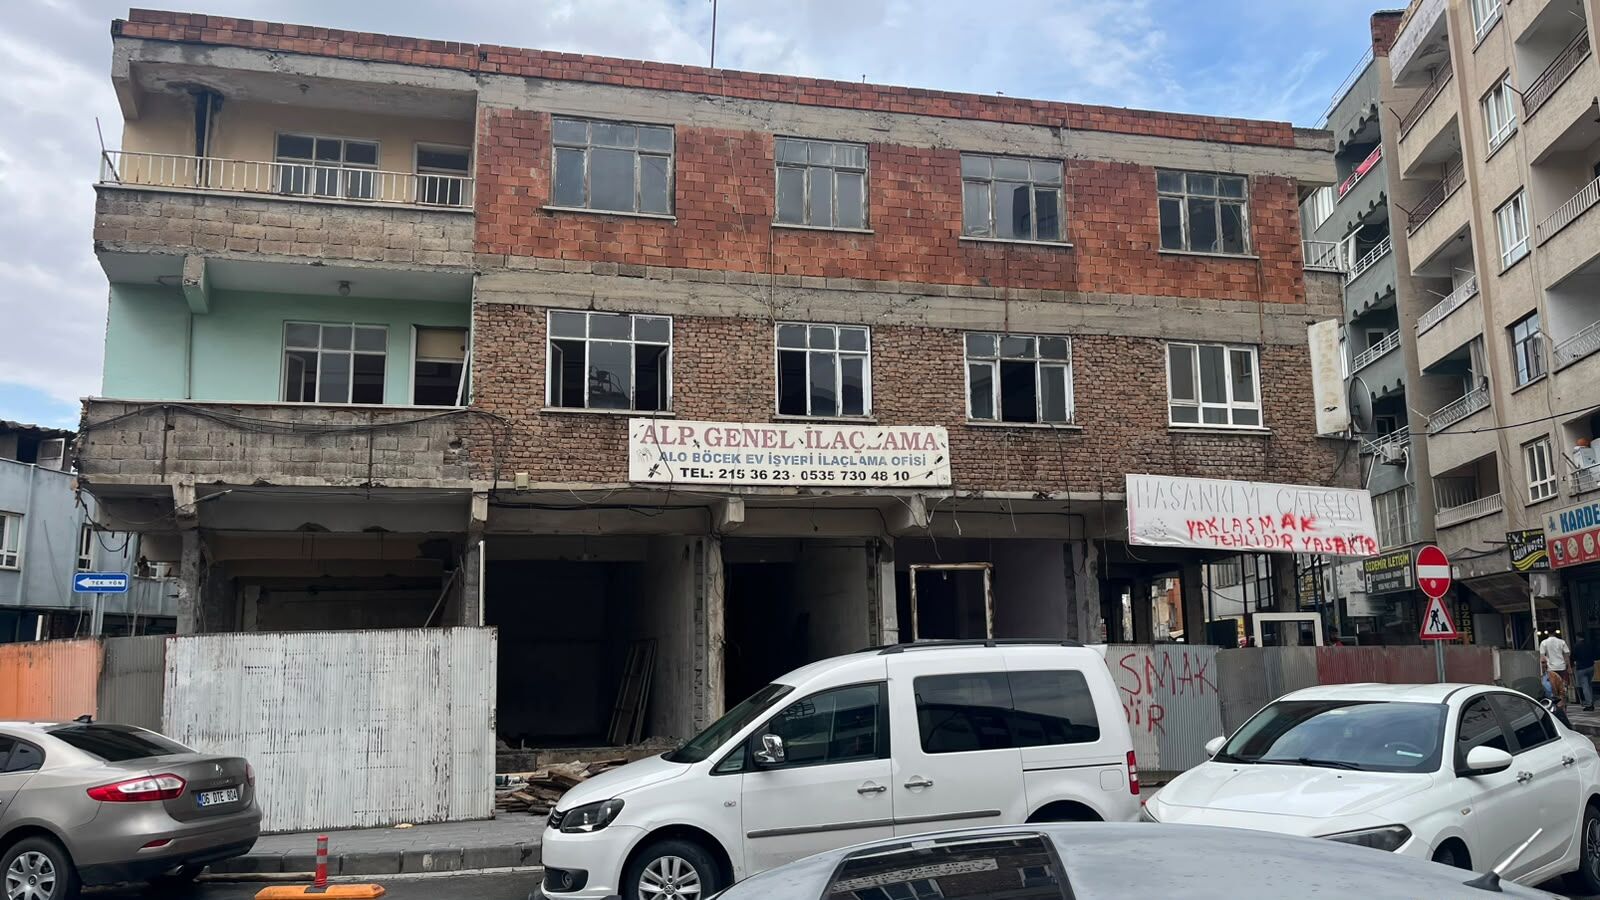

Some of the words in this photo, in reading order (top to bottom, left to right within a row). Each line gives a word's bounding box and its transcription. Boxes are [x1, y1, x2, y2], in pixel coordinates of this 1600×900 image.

[640, 425, 694, 446] ALP
[704, 427, 795, 449] GENEL
[659, 452, 687, 462] ALO
[692, 450, 741, 464] BÖCEK
[746, 454, 764, 464] EV
[818, 452, 888, 467] İLAÇLAMA
[891, 454, 926, 466] OFİSİ
[680, 467, 714, 478] TEL:
[719, 469, 745, 480] 215
[750, 469, 768, 480] 36
[801, 470, 835, 481] 0535
[840, 470, 867, 481] 730
[871, 470, 889, 481] 48
[893, 471, 910, 481] 10
